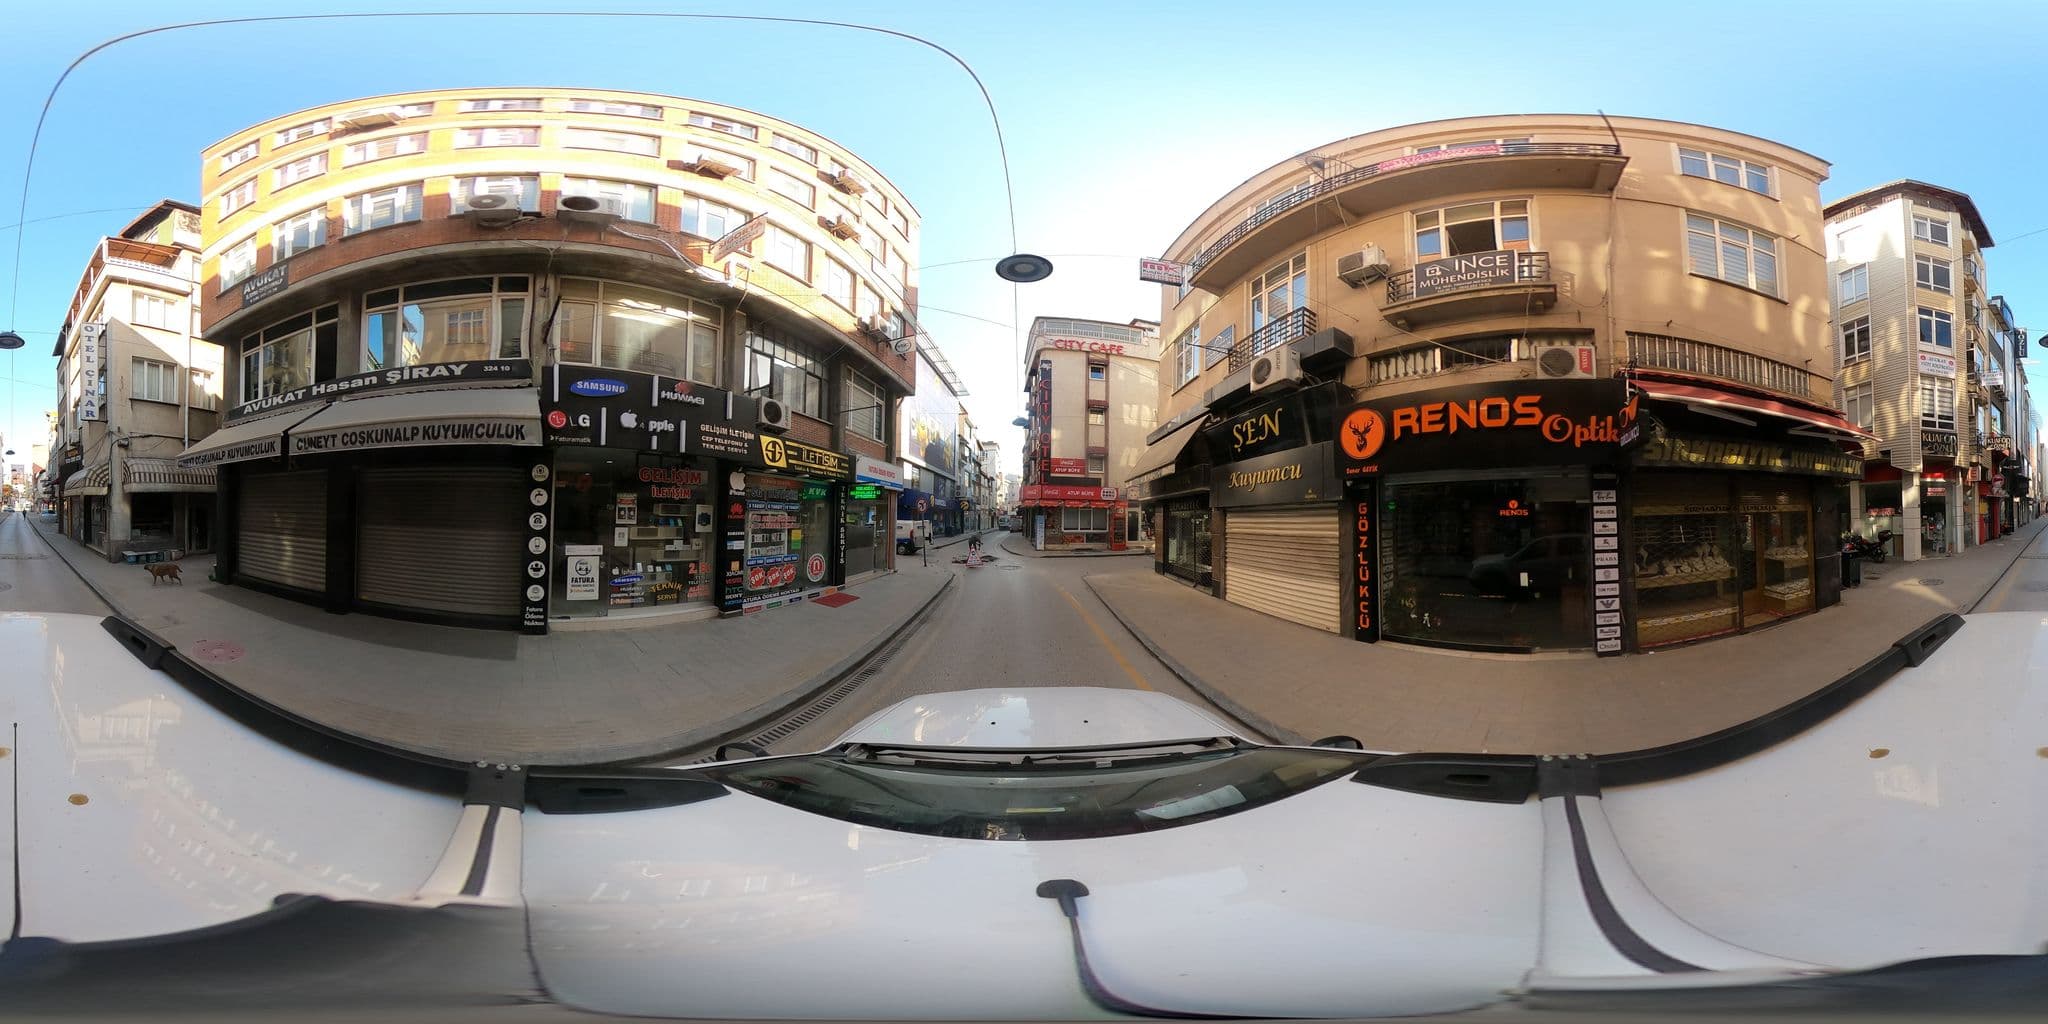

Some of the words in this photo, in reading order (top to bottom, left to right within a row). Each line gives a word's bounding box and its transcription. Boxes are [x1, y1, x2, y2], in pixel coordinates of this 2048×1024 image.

[84, 326, 95, 363] OTEL
[1054, 339, 1086, 350] CITY
[1089, 342, 1124, 355] CAFE
[243, 389, 304, 415] AVUKAT
[312, 375, 378, 396] Hasan
[386, 363, 469, 384] ŞİRAY
[576, 381, 625, 393] SAMSUNG
[1233, 408, 1283, 452] ŞEN
[1393, 395, 1544, 441] RENOS
[1542, 414, 1620, 447] Optik
[341, 430, 419, 446] COŞKUNALP
[422, 422, 526, 441] KUYUMCULUK
[227, 441, 276, 458] KUYUMCULUK
[639, 467, 701, 485] GELİŞİM
[1228, 464, 1303, 492] Kuyumcu
[652, 486, 691, 499] İLETİŞİM
[808, 487, 827, 496] KVK
[650, 581, 684, 592] TEKNİK
